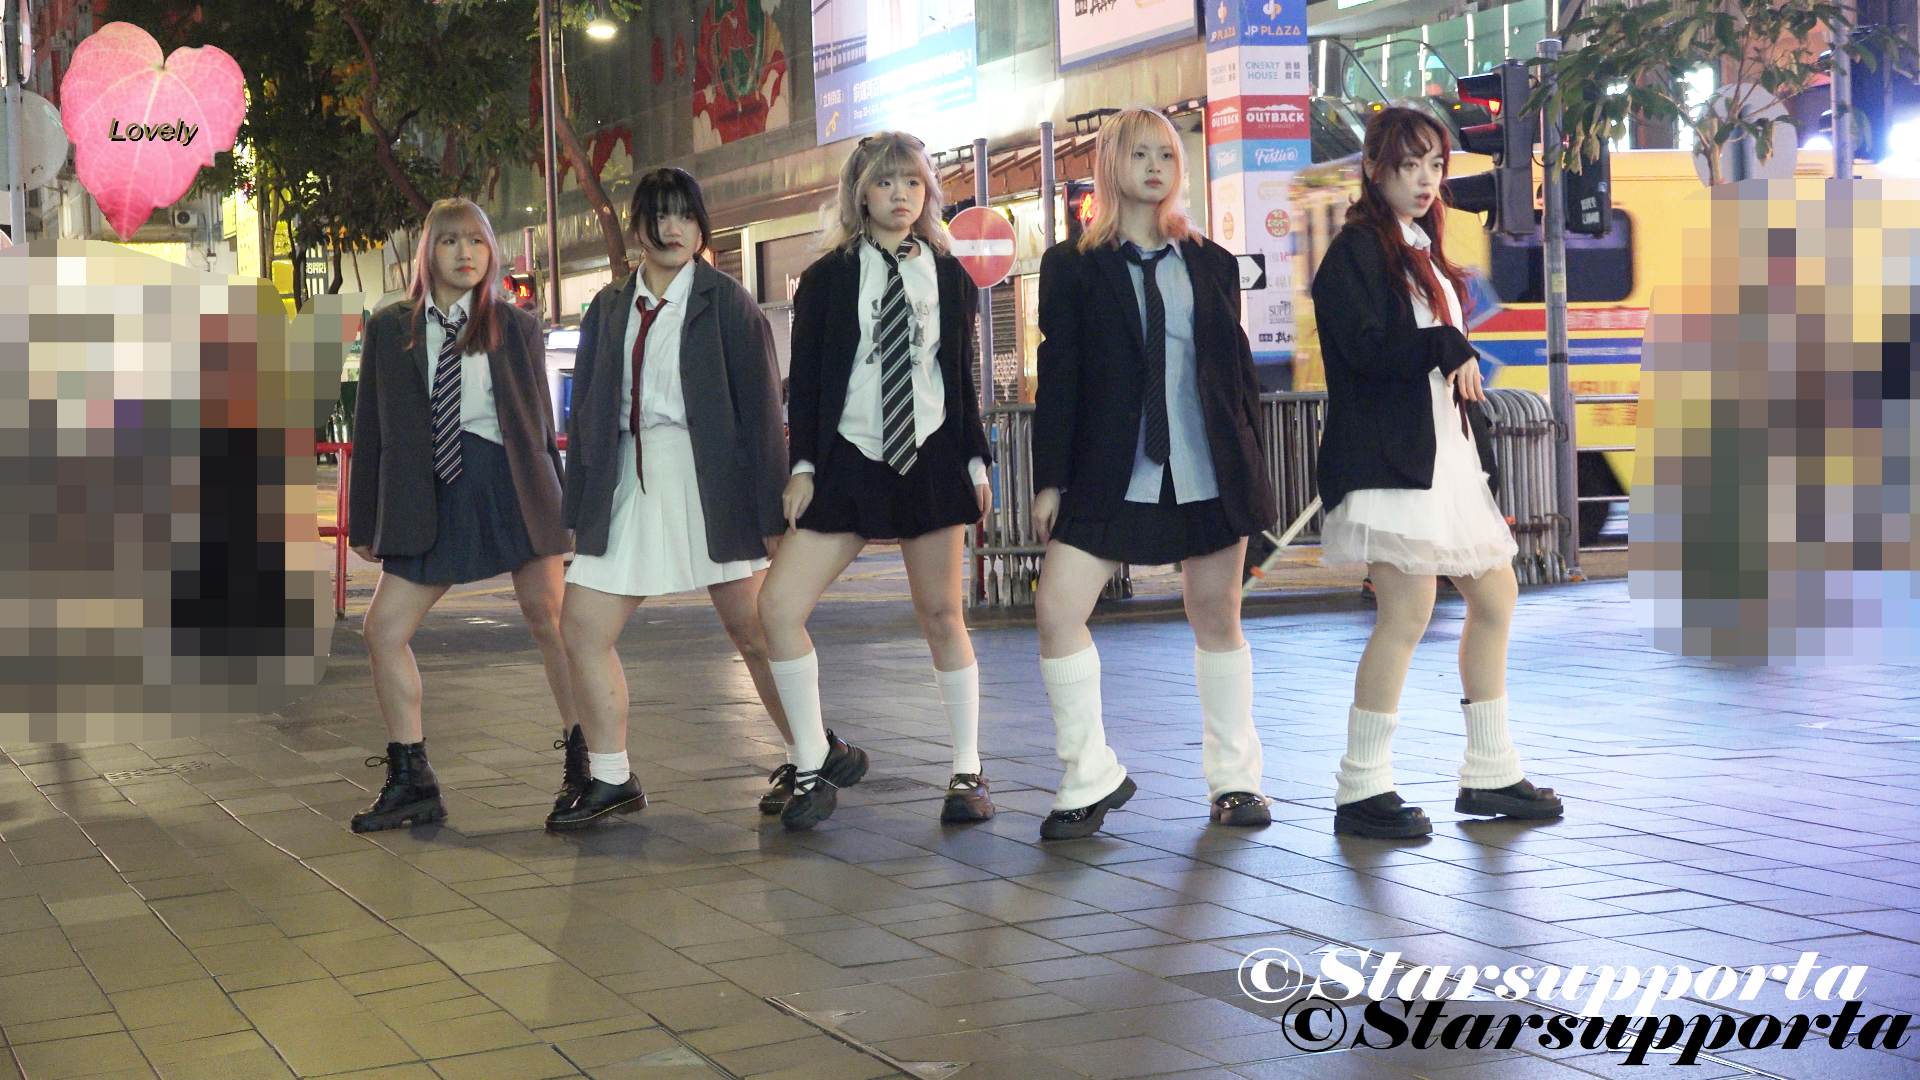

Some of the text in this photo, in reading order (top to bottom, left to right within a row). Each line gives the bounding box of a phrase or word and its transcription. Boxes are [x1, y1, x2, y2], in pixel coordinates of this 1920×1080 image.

[1245, 25, 1301, 36] JP PLAZA
[1245, 61, 1279, 70] CINEART
[1247, 71, 1278, 80] HOUSE
[1211, 112, 1239, 128] OUTBACK
[1246, 112, 1305, 123] OUTBACK
